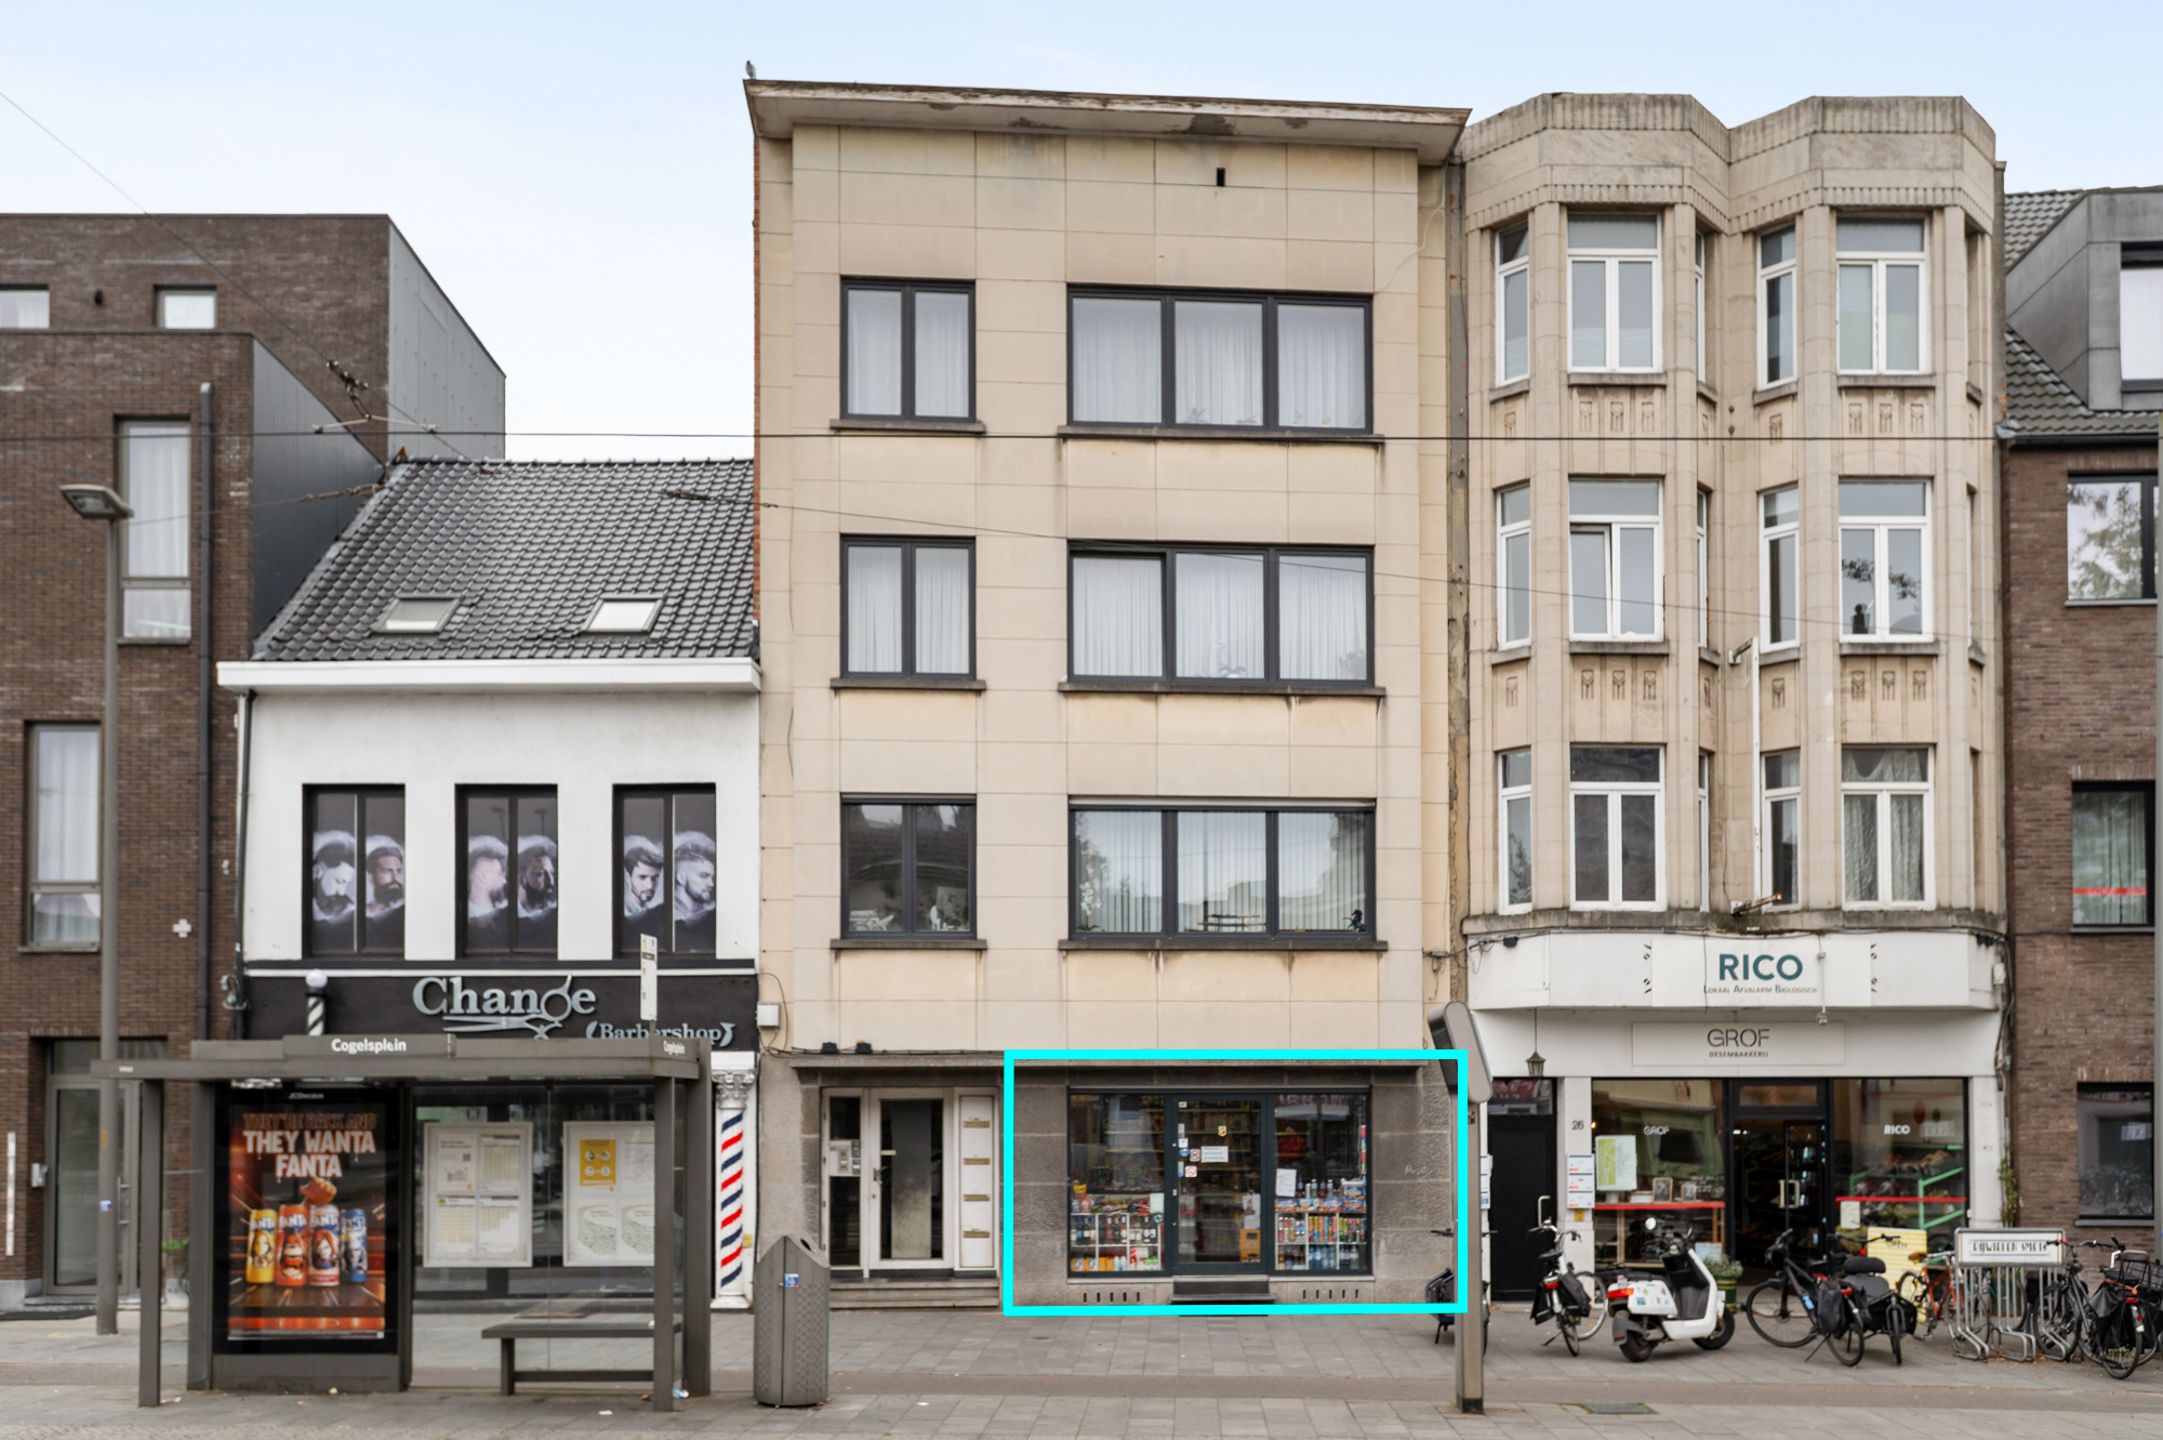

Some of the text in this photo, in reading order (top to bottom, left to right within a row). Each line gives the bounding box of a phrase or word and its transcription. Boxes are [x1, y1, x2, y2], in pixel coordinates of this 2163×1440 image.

[1719, 953, 1804, 981] RICO
[412, 973, 597, 1020] Change
[331, 1037, 407, 1055] Cogelsplein
[1706, 1028, 1770, 1047] GROF
[1572, 1120, 1585, 1130] 26
[1643, 1124, 1670, 1135] GROF
[1884, 1124, 1911, 1135] RICO
[243, 1130, 376, 1153] THEY WANTA
[275, 1154, 342, 1177] FANTA
